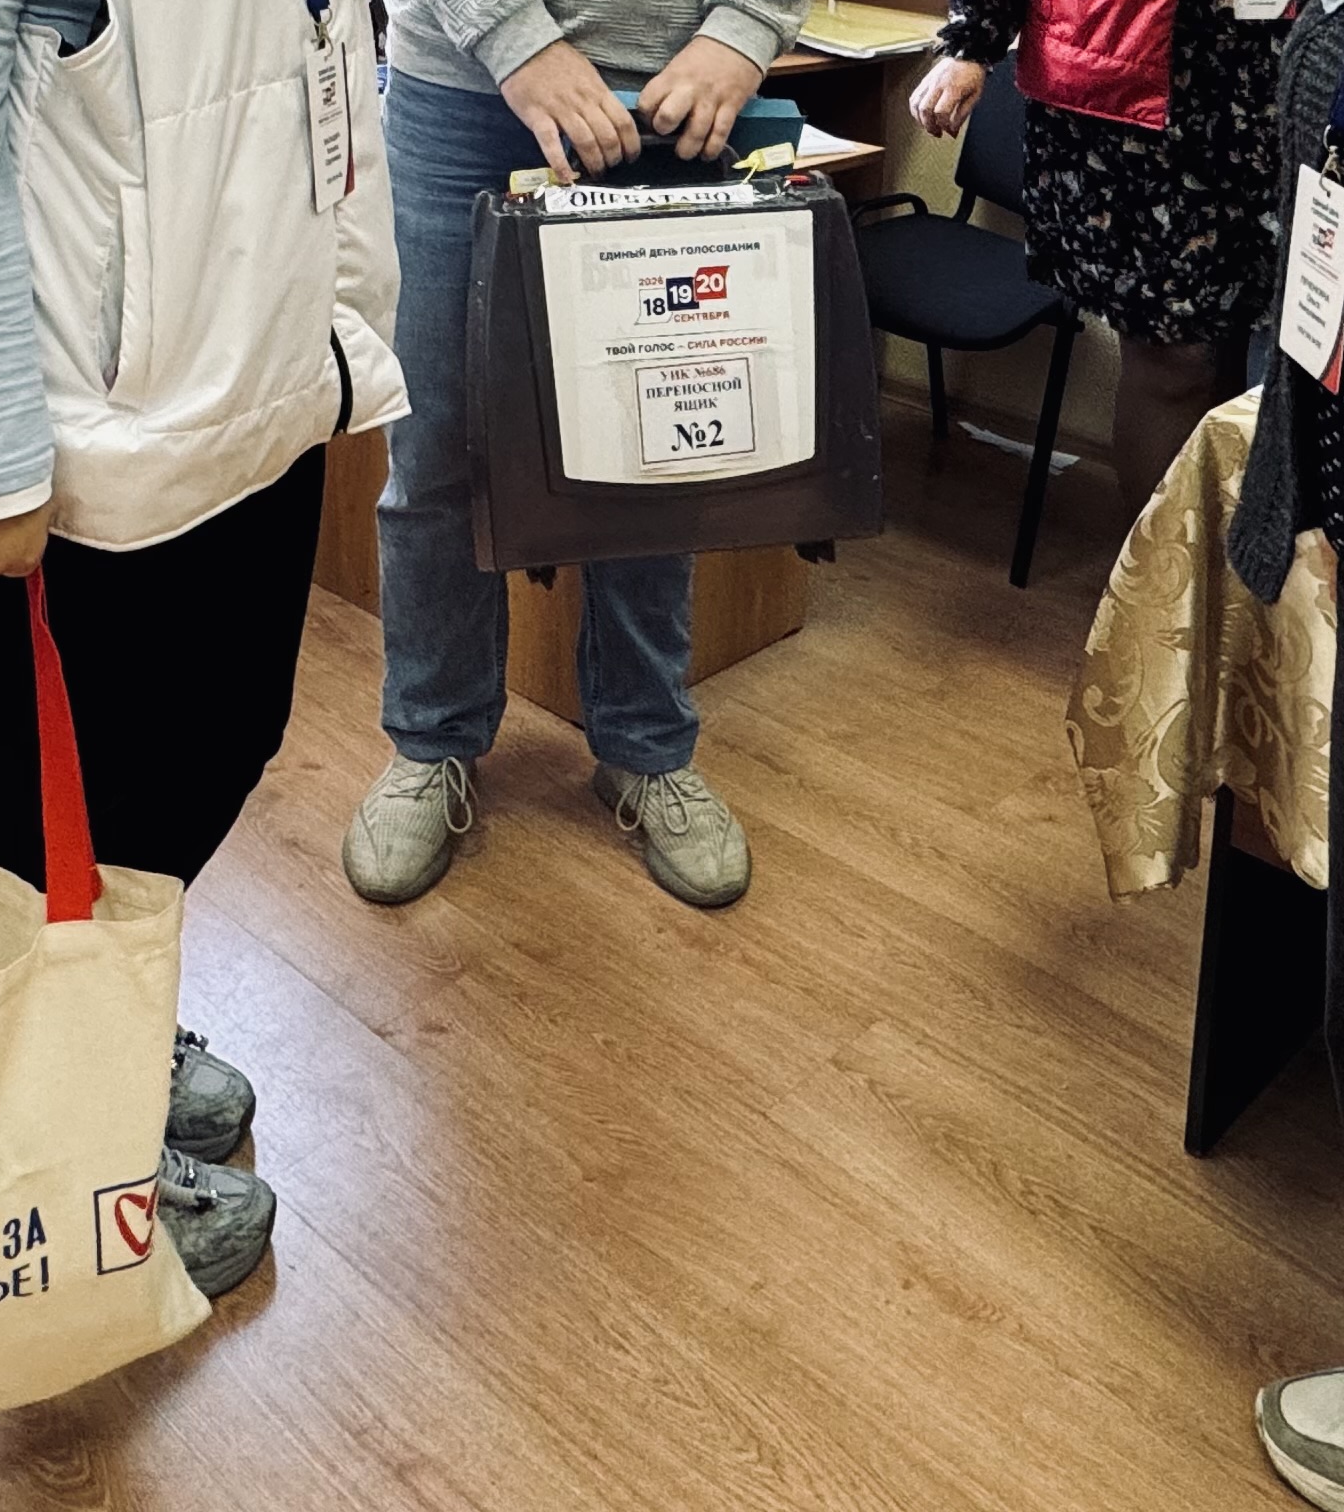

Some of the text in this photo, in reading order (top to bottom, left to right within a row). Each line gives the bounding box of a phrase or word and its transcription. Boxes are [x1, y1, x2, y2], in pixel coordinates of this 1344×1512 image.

[599, 241, 761, 262] ЕДИНЫЙ ДЕНЬ ГОЛОСОВАНИЯ
[642, 273, 724, 317] 18 19 20
[673, 311, 730, 323] СЕНТЯБРЯ
[605, 343, 636, 356] ТВОЙ
[638, 342, 675, 354] ГОЛОС
[687, 338, 717, 349] СИЛА
[719, 336, 768, 347] РОССИИ!
[660, 368, 690, 382] УИК
[646, 377, 742, 399] ПЕРЕНОСНОЙ
[674, 397, 718, 412] ЯЩИК
[671, 419, 725, 451] №2
[3, 1206, 47, 1259] ЗА
